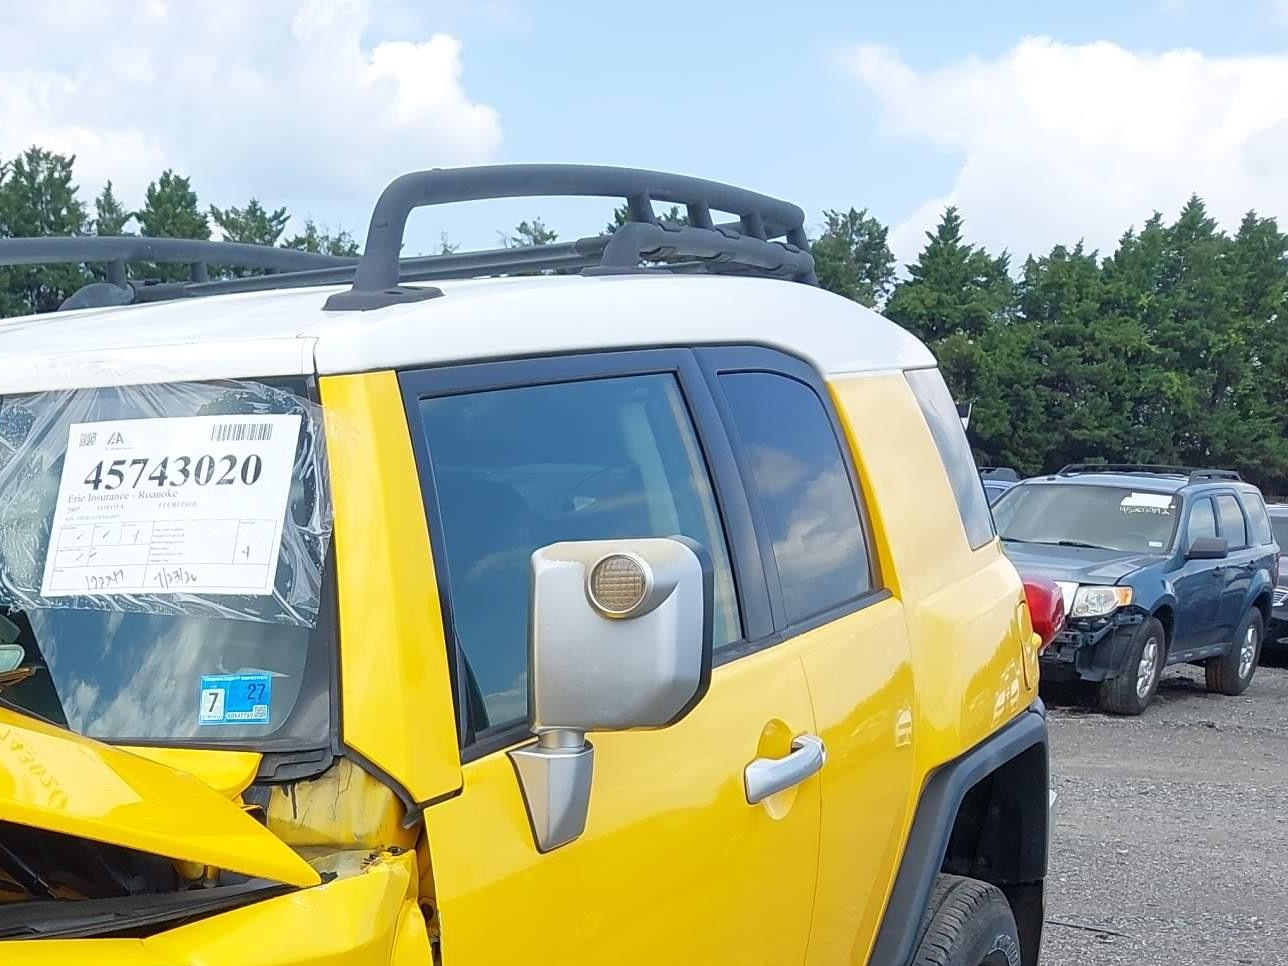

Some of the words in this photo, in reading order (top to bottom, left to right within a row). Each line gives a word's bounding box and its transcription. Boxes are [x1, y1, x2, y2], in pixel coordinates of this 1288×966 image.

[83, 454, 263, 491] 45743020
[67, 493, 86, 504] Erie
[87, 492, 130, 503] Insurance
[137, 489, 179, 501] Roanoke
[208, 692, 219, 713] 7
[247, 683, 266, 702] 27
